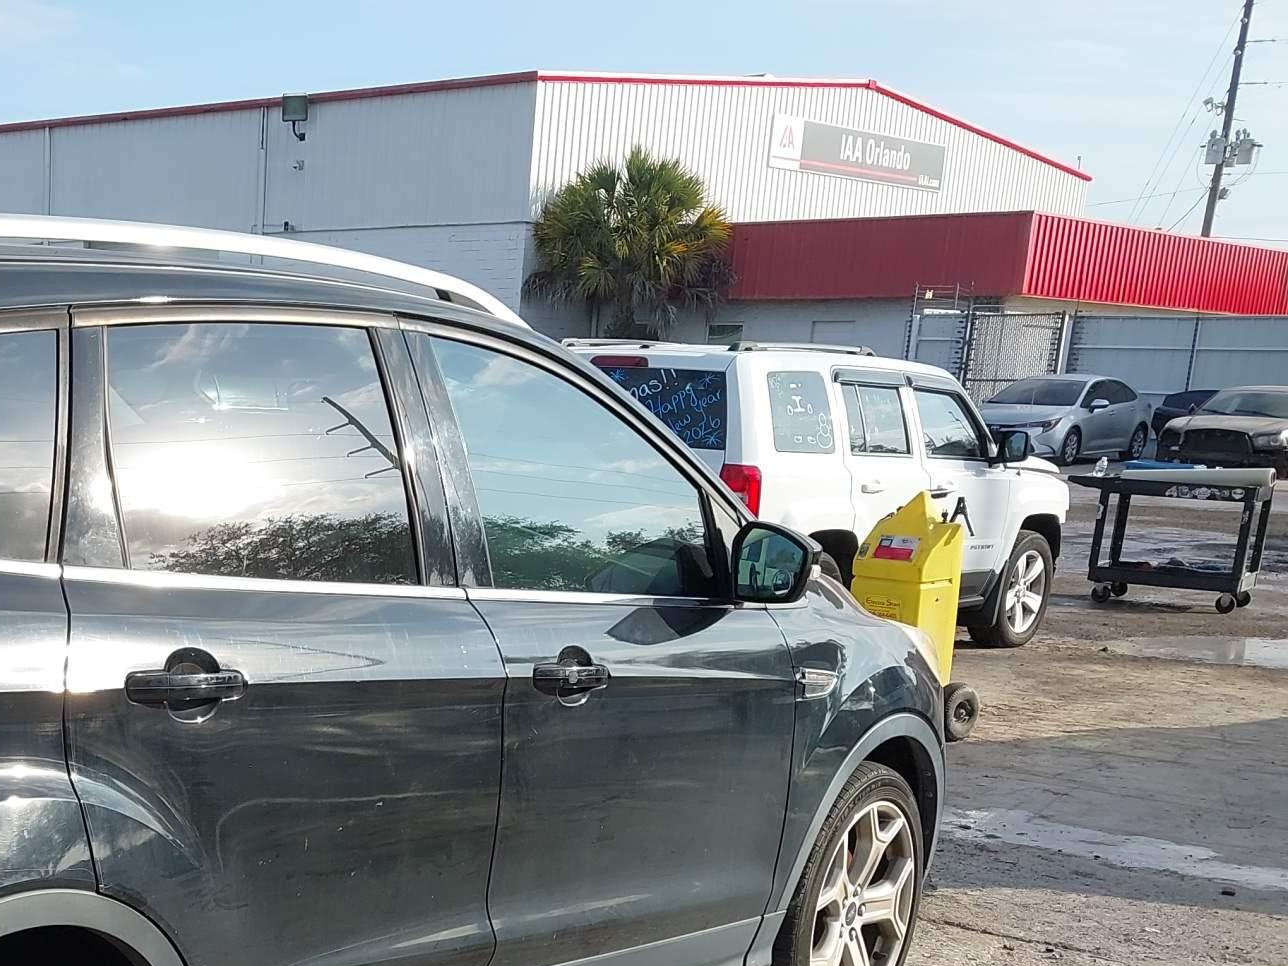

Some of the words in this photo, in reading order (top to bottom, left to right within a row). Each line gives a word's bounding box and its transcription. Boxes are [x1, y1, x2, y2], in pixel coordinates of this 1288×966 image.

[840, 134, 863, 163] IAA
[866, 139, 911, 171] Orlando
[683, 416, 721, 444] 2026
